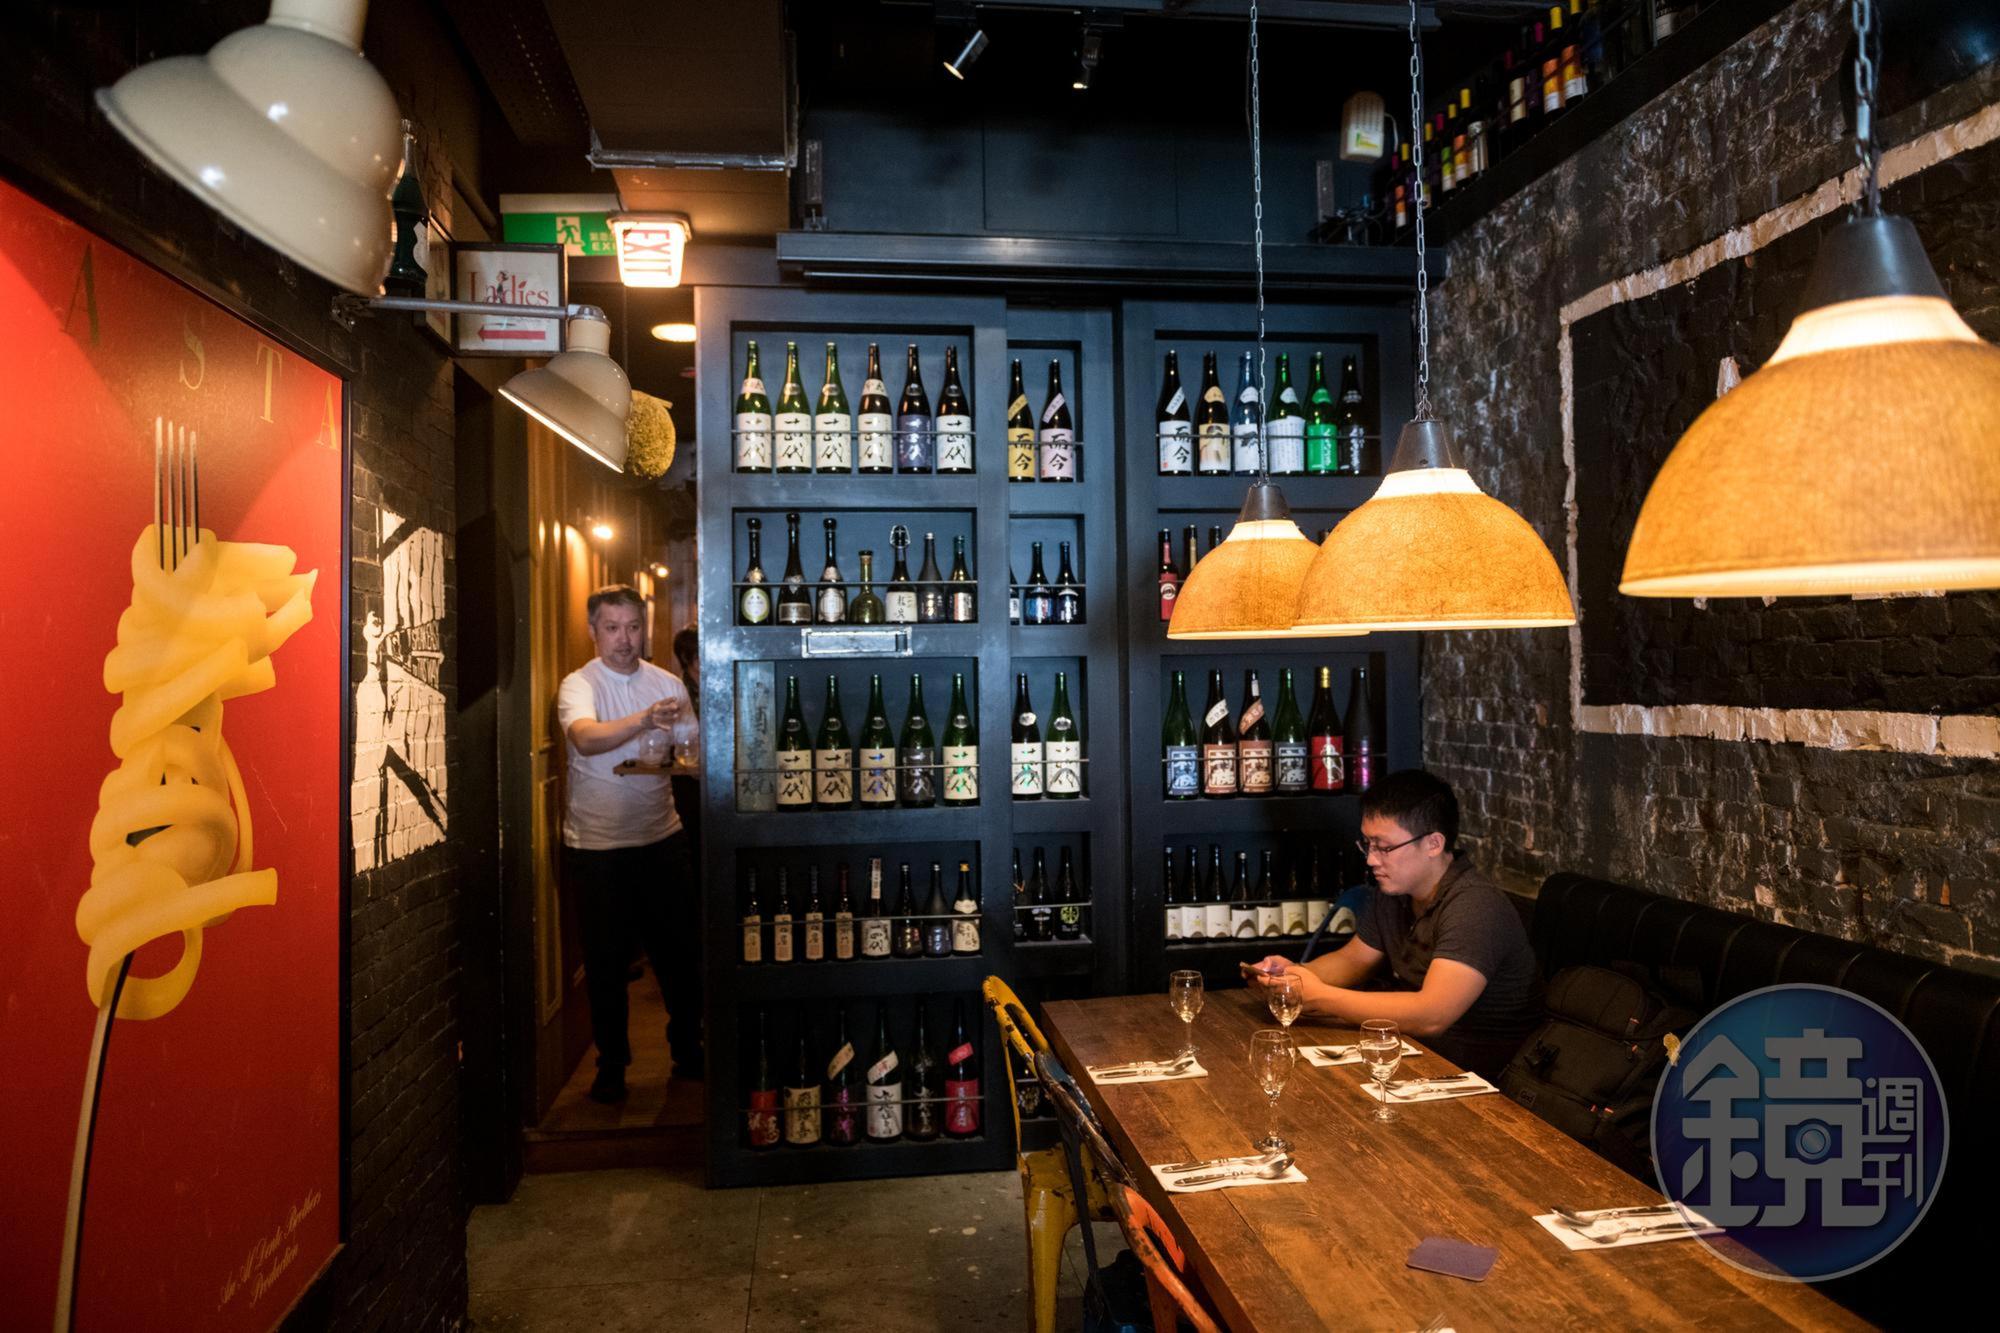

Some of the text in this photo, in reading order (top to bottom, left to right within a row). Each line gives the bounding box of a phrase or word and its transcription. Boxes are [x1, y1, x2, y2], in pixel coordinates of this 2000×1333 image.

[591, 241, 617, 252] EXI
[623, 229, 672, 276] EXIT
[468, 270, 549, 305] Ladies
